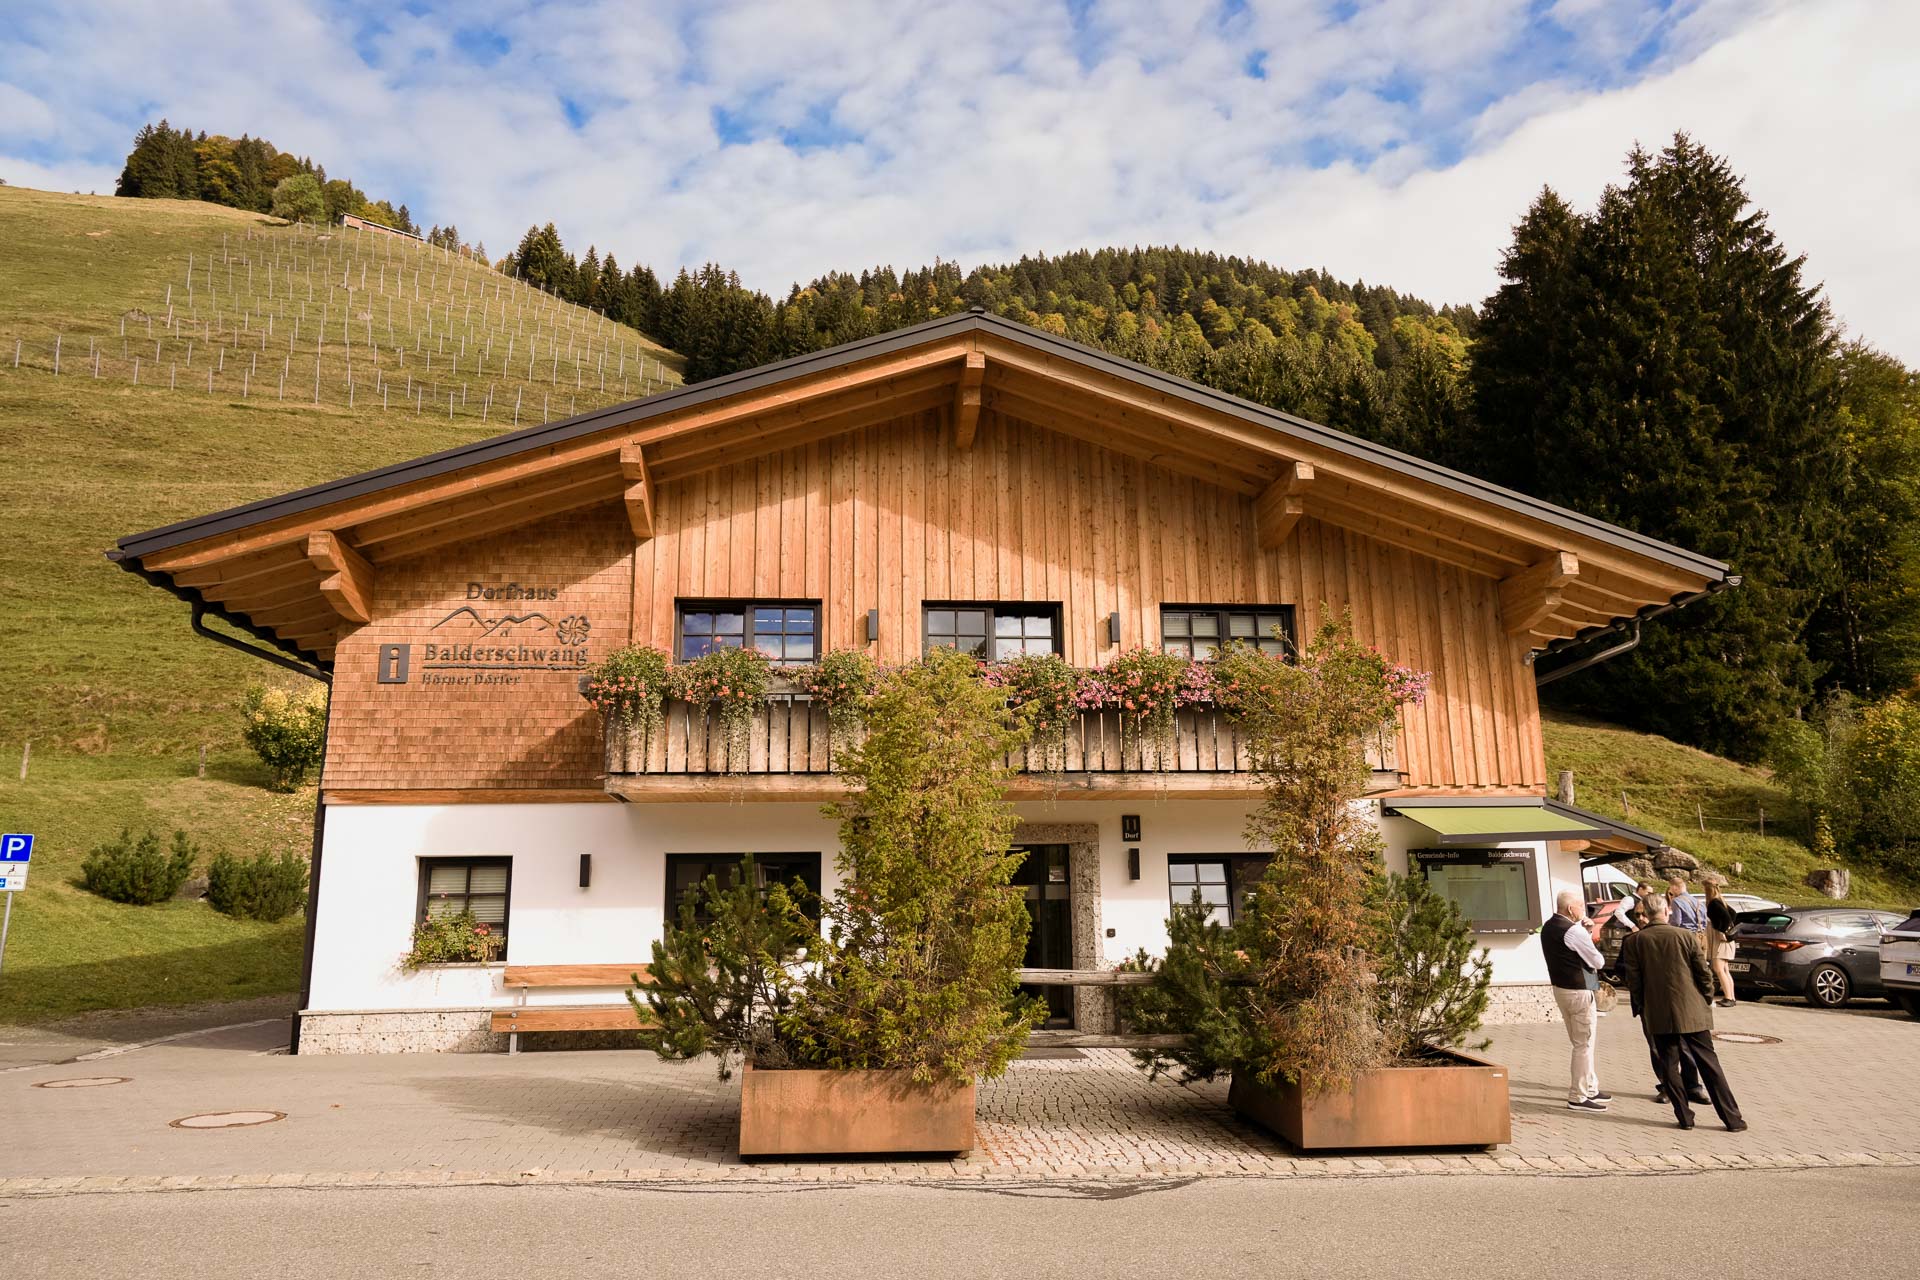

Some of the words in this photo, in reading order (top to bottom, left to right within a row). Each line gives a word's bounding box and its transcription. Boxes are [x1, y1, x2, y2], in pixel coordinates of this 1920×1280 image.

[466, 582, 558, 600] Dorfhaus
[425, 643, 588, 664] Balderschwang
[6, 837, 26, 859] P
[1487, 851, 1531, 859] Balderschwang
